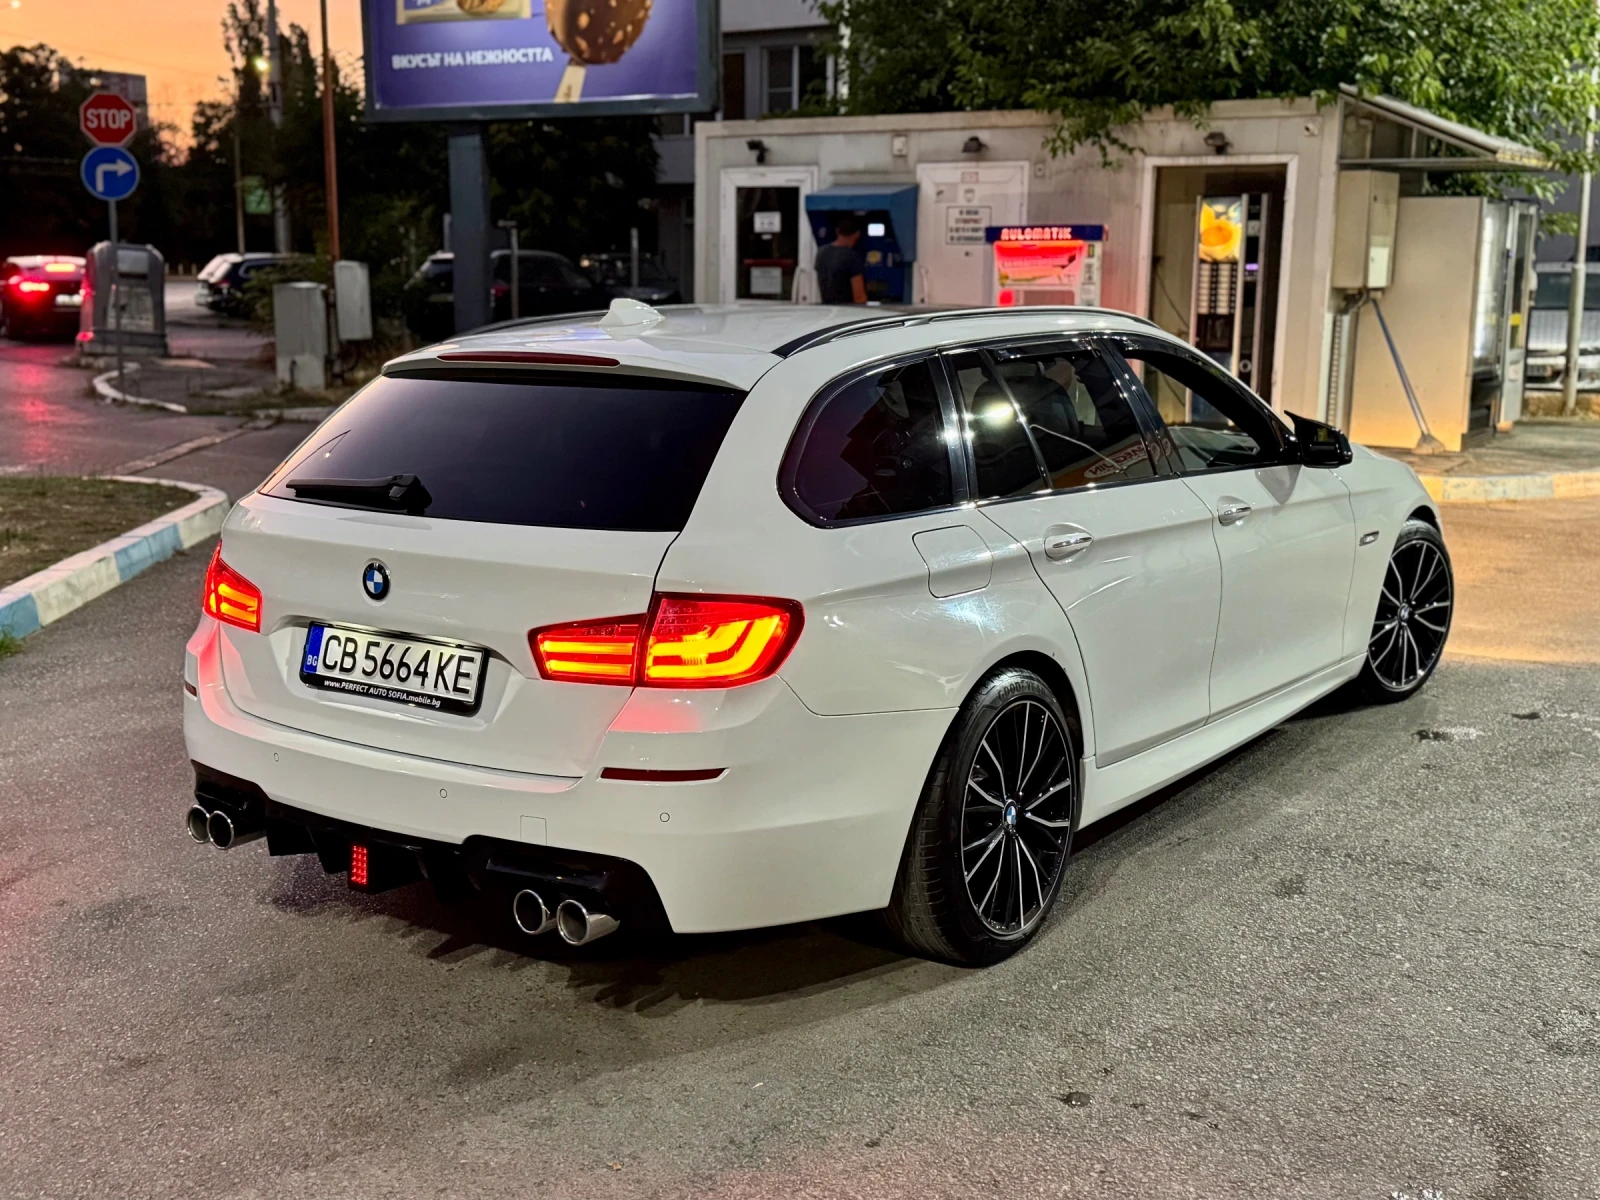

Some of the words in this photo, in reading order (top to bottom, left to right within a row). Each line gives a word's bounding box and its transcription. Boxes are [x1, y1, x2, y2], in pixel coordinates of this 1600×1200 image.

[392, 53, 441, 70] ВКУСЪТ
[443, 51, 464, 66] НА
[465, 47, 554, 65] НЕЖНОСТТА
[86, 107, 131, 129] STOP
[306, 654, 318, 666] BG
[361, 640, 431, 687] 5664
[324, 680, 369, 693] www.PERFECT
[368, 687, 387, 697] AUTO
[388, 691, 441, 708] SOFIA.mobile.bg
